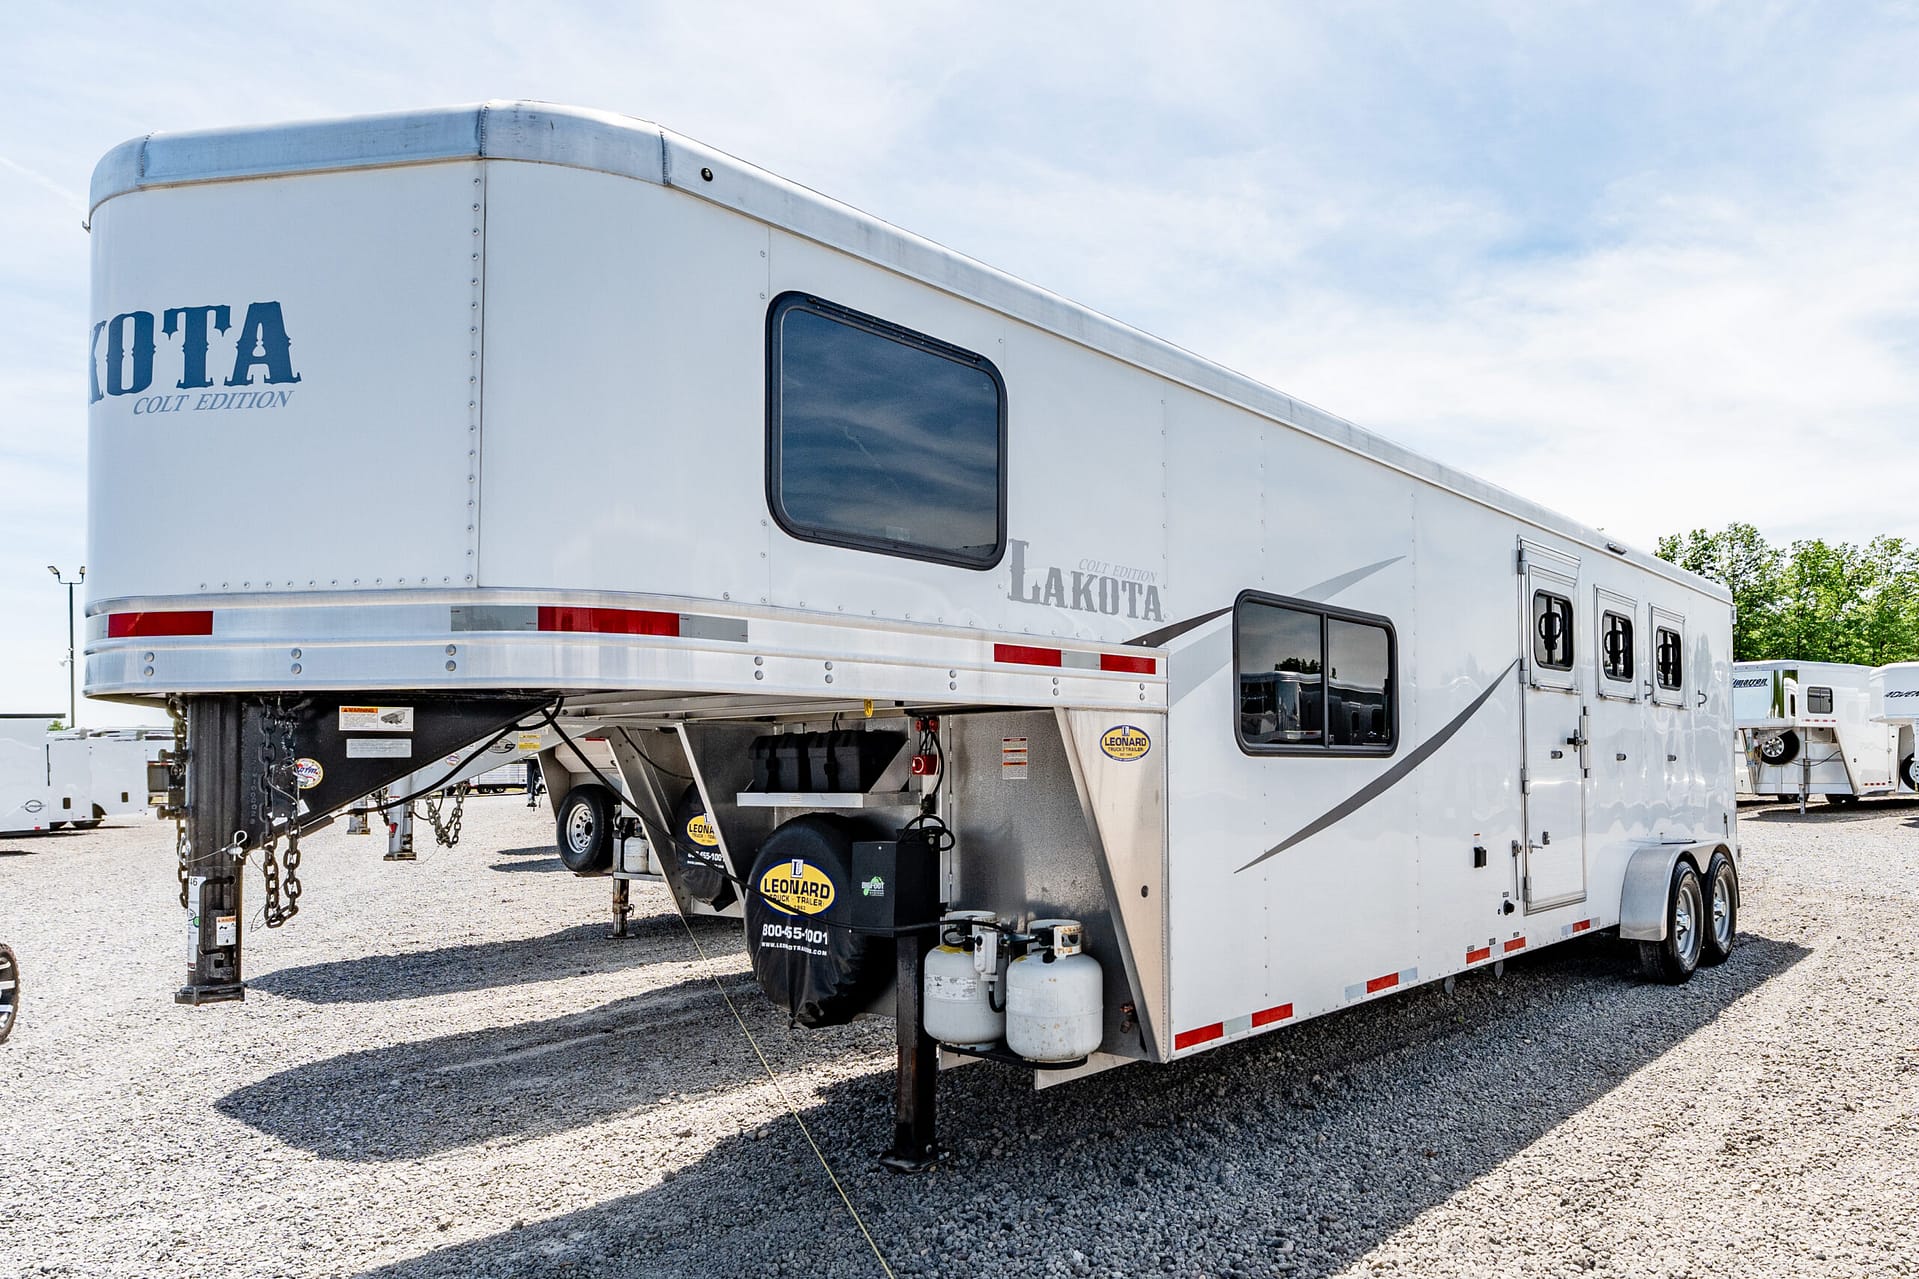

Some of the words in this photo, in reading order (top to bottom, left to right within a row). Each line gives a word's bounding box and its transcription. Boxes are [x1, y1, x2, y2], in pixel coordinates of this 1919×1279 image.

[133, 394, 190, 415] COLT
[192, 390, 295, 411] EDITION
[1078, 557, 1110, 574] COLT
[1112, 564, 1158, 583] EDITION
[1104, 737, 1147, 747] LEONARD
[689, 823, 716, 834] LEONA
[764, 878, 830, 899] LEONARD
